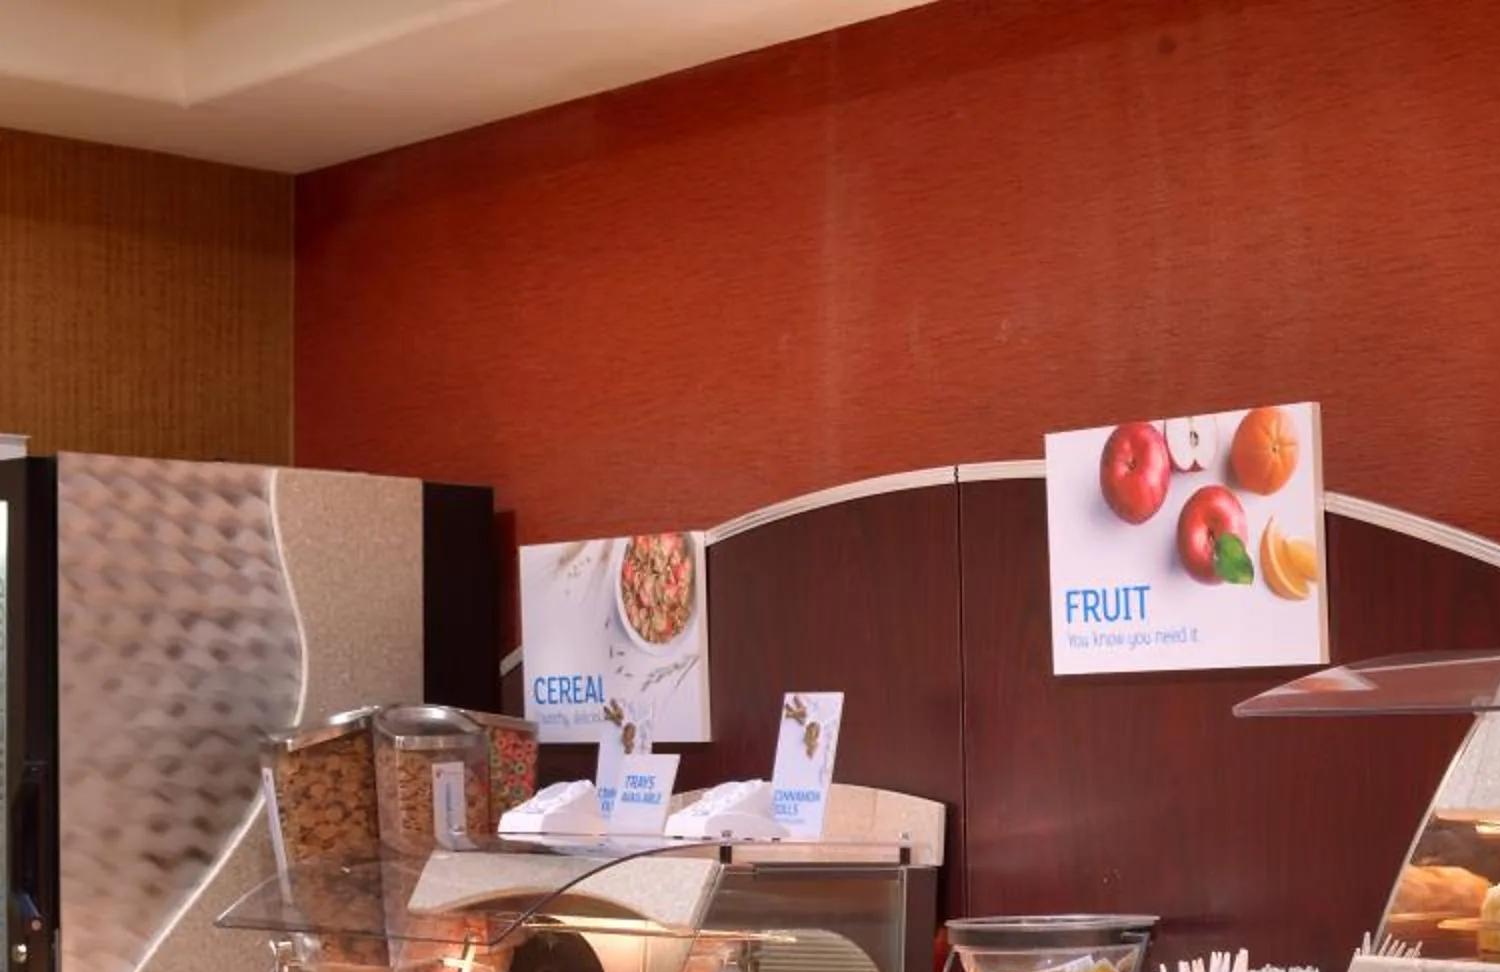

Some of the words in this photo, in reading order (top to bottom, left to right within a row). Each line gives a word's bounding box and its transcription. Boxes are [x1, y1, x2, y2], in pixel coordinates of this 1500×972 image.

[1065, 585, 1151, 624] FRUIT
[1093, 630, 1124, 647] know
[1128, 632, 1152, 651] you
[1155, 627, 1187, 644] need
[533, 674, 605, 705] CEREAL
